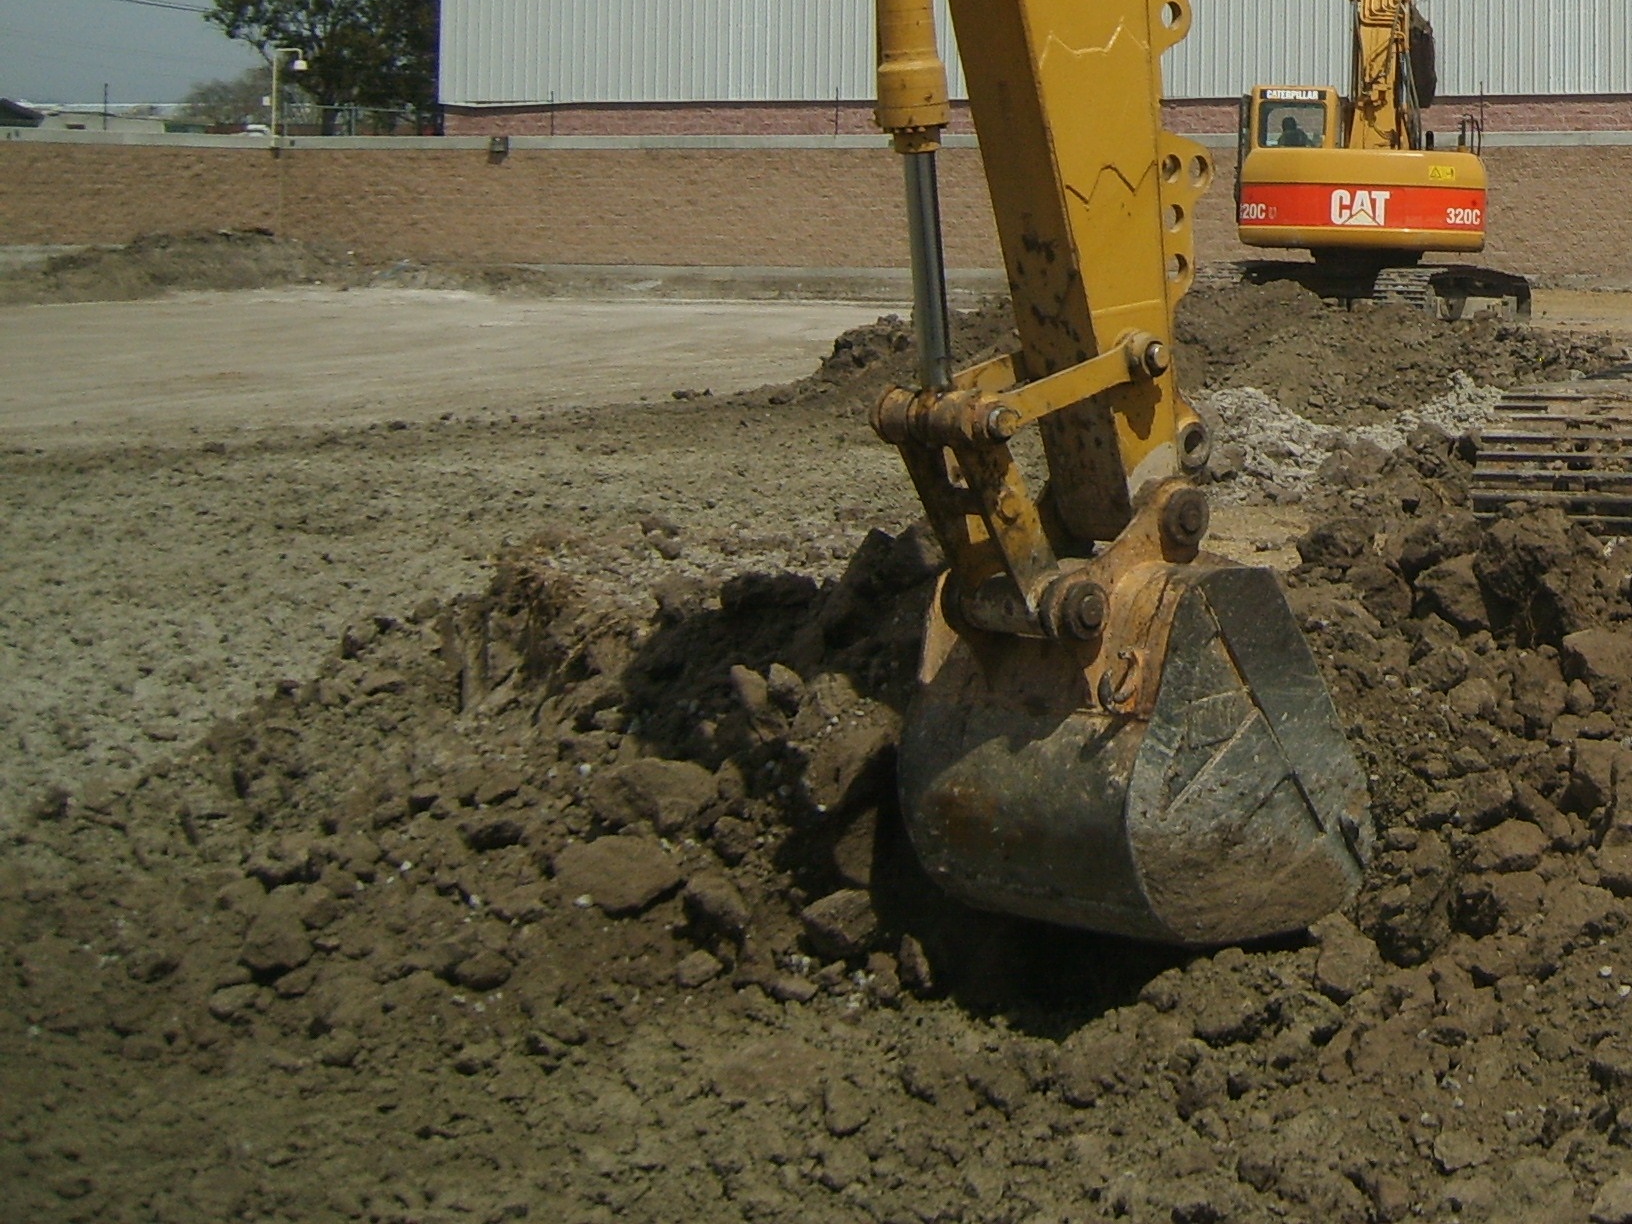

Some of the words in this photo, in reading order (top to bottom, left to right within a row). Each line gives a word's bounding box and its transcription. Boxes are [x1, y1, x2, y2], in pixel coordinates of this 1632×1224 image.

[1266, 89, 1319, 100] CATERPILLAR
[1330, 189, 1391, 226] CAT
[1446, 208, 1481, 225] 320C
